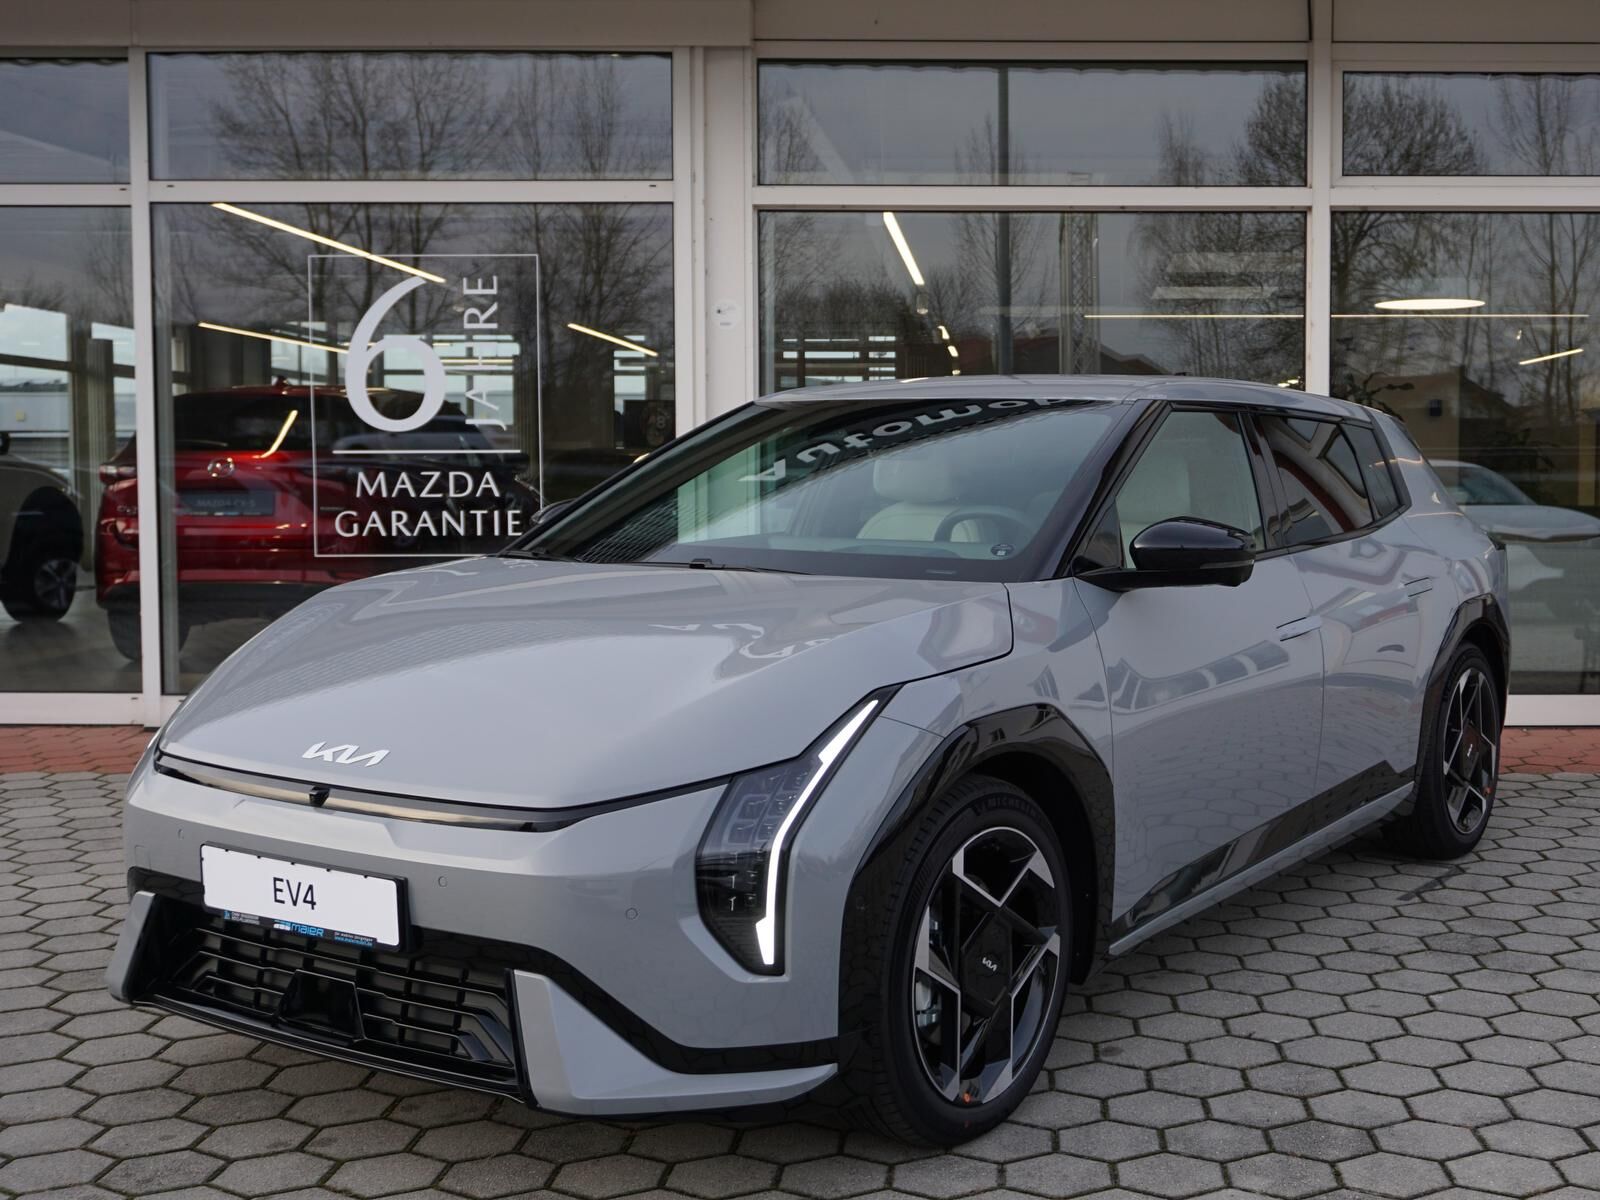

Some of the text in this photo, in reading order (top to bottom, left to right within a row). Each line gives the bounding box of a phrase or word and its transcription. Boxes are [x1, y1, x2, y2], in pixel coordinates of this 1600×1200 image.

[345, 275, 507, 432] 6 JAHRE
[355, 471, 501, 498] MAZDA
[334, 509, 523, 538] GARANTIE
[302, 740, 390, 768] KIA
[272, 876, 317, 911] EV4
